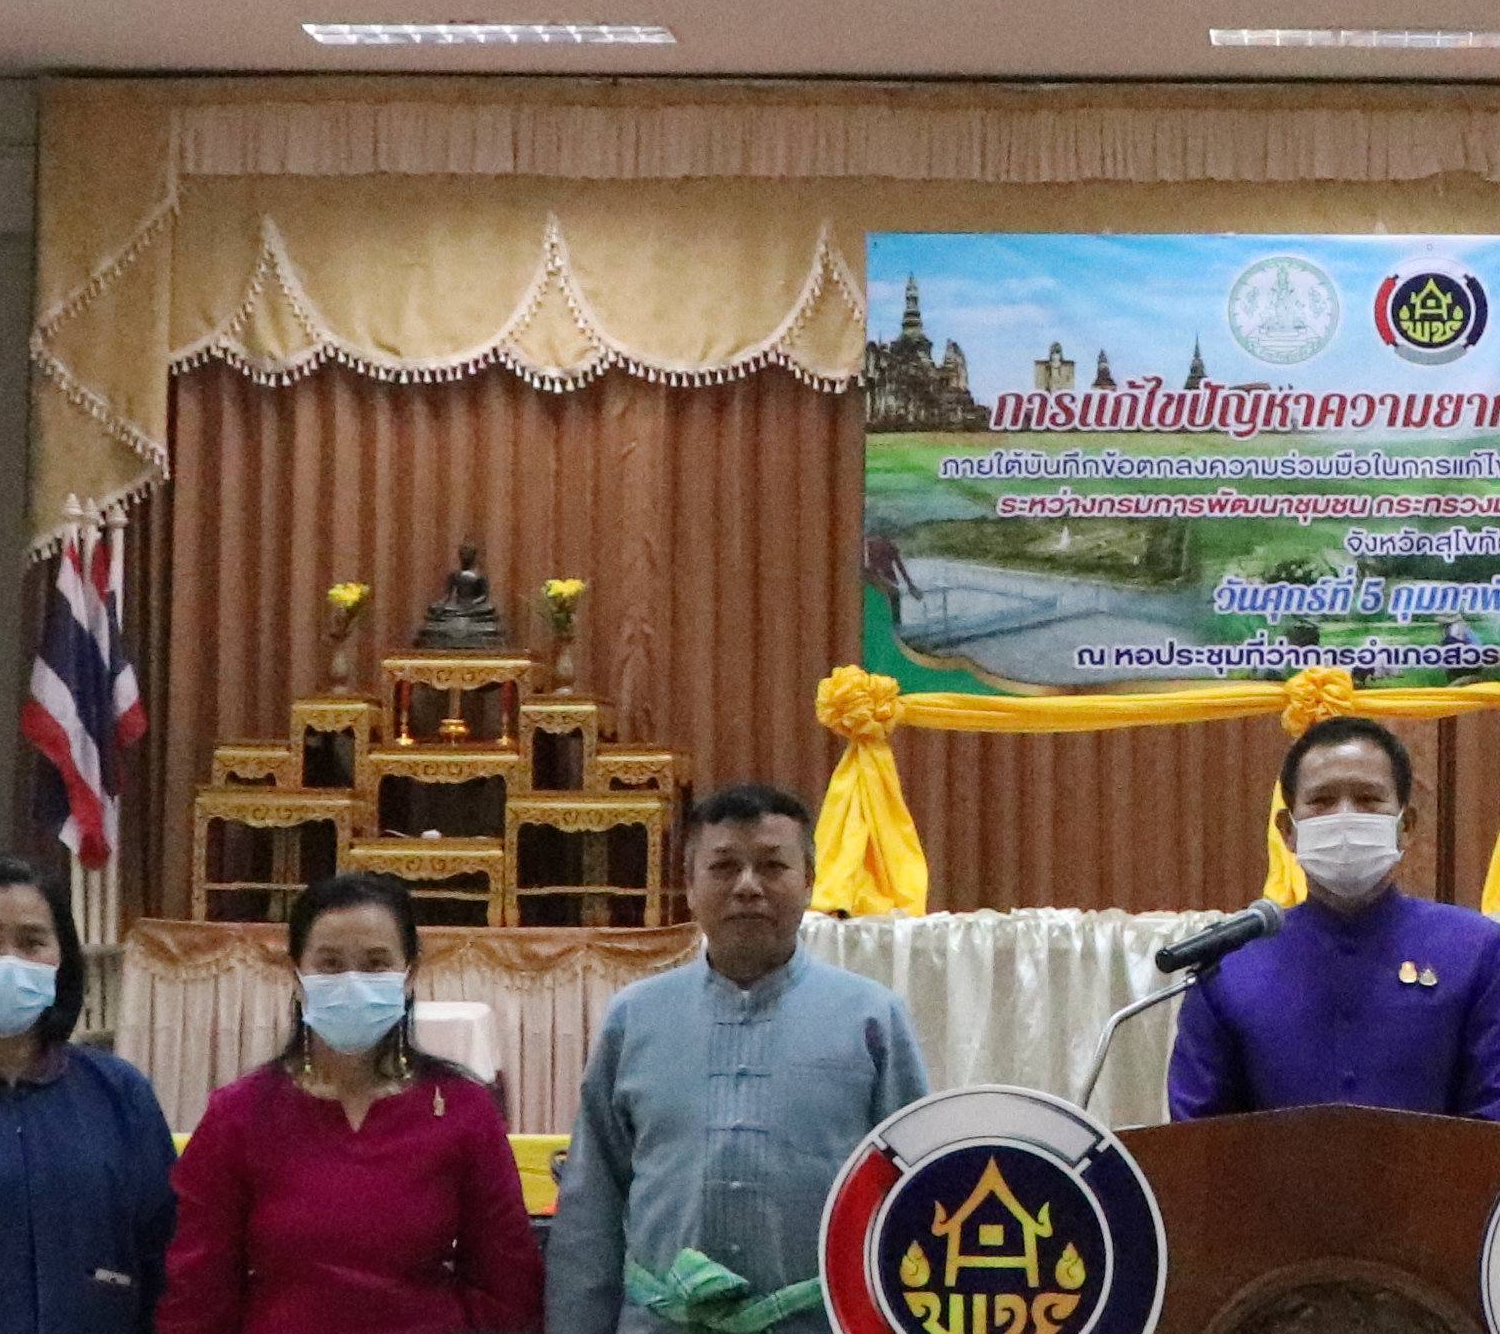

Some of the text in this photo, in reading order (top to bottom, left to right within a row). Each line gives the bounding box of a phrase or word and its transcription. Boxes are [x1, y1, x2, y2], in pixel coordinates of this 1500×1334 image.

[1215, 567, 1356, 621] วันศุกร์ที่
[1361, 579, 1385, 612] 5
[1077, 646, 1104, 666] ณ
